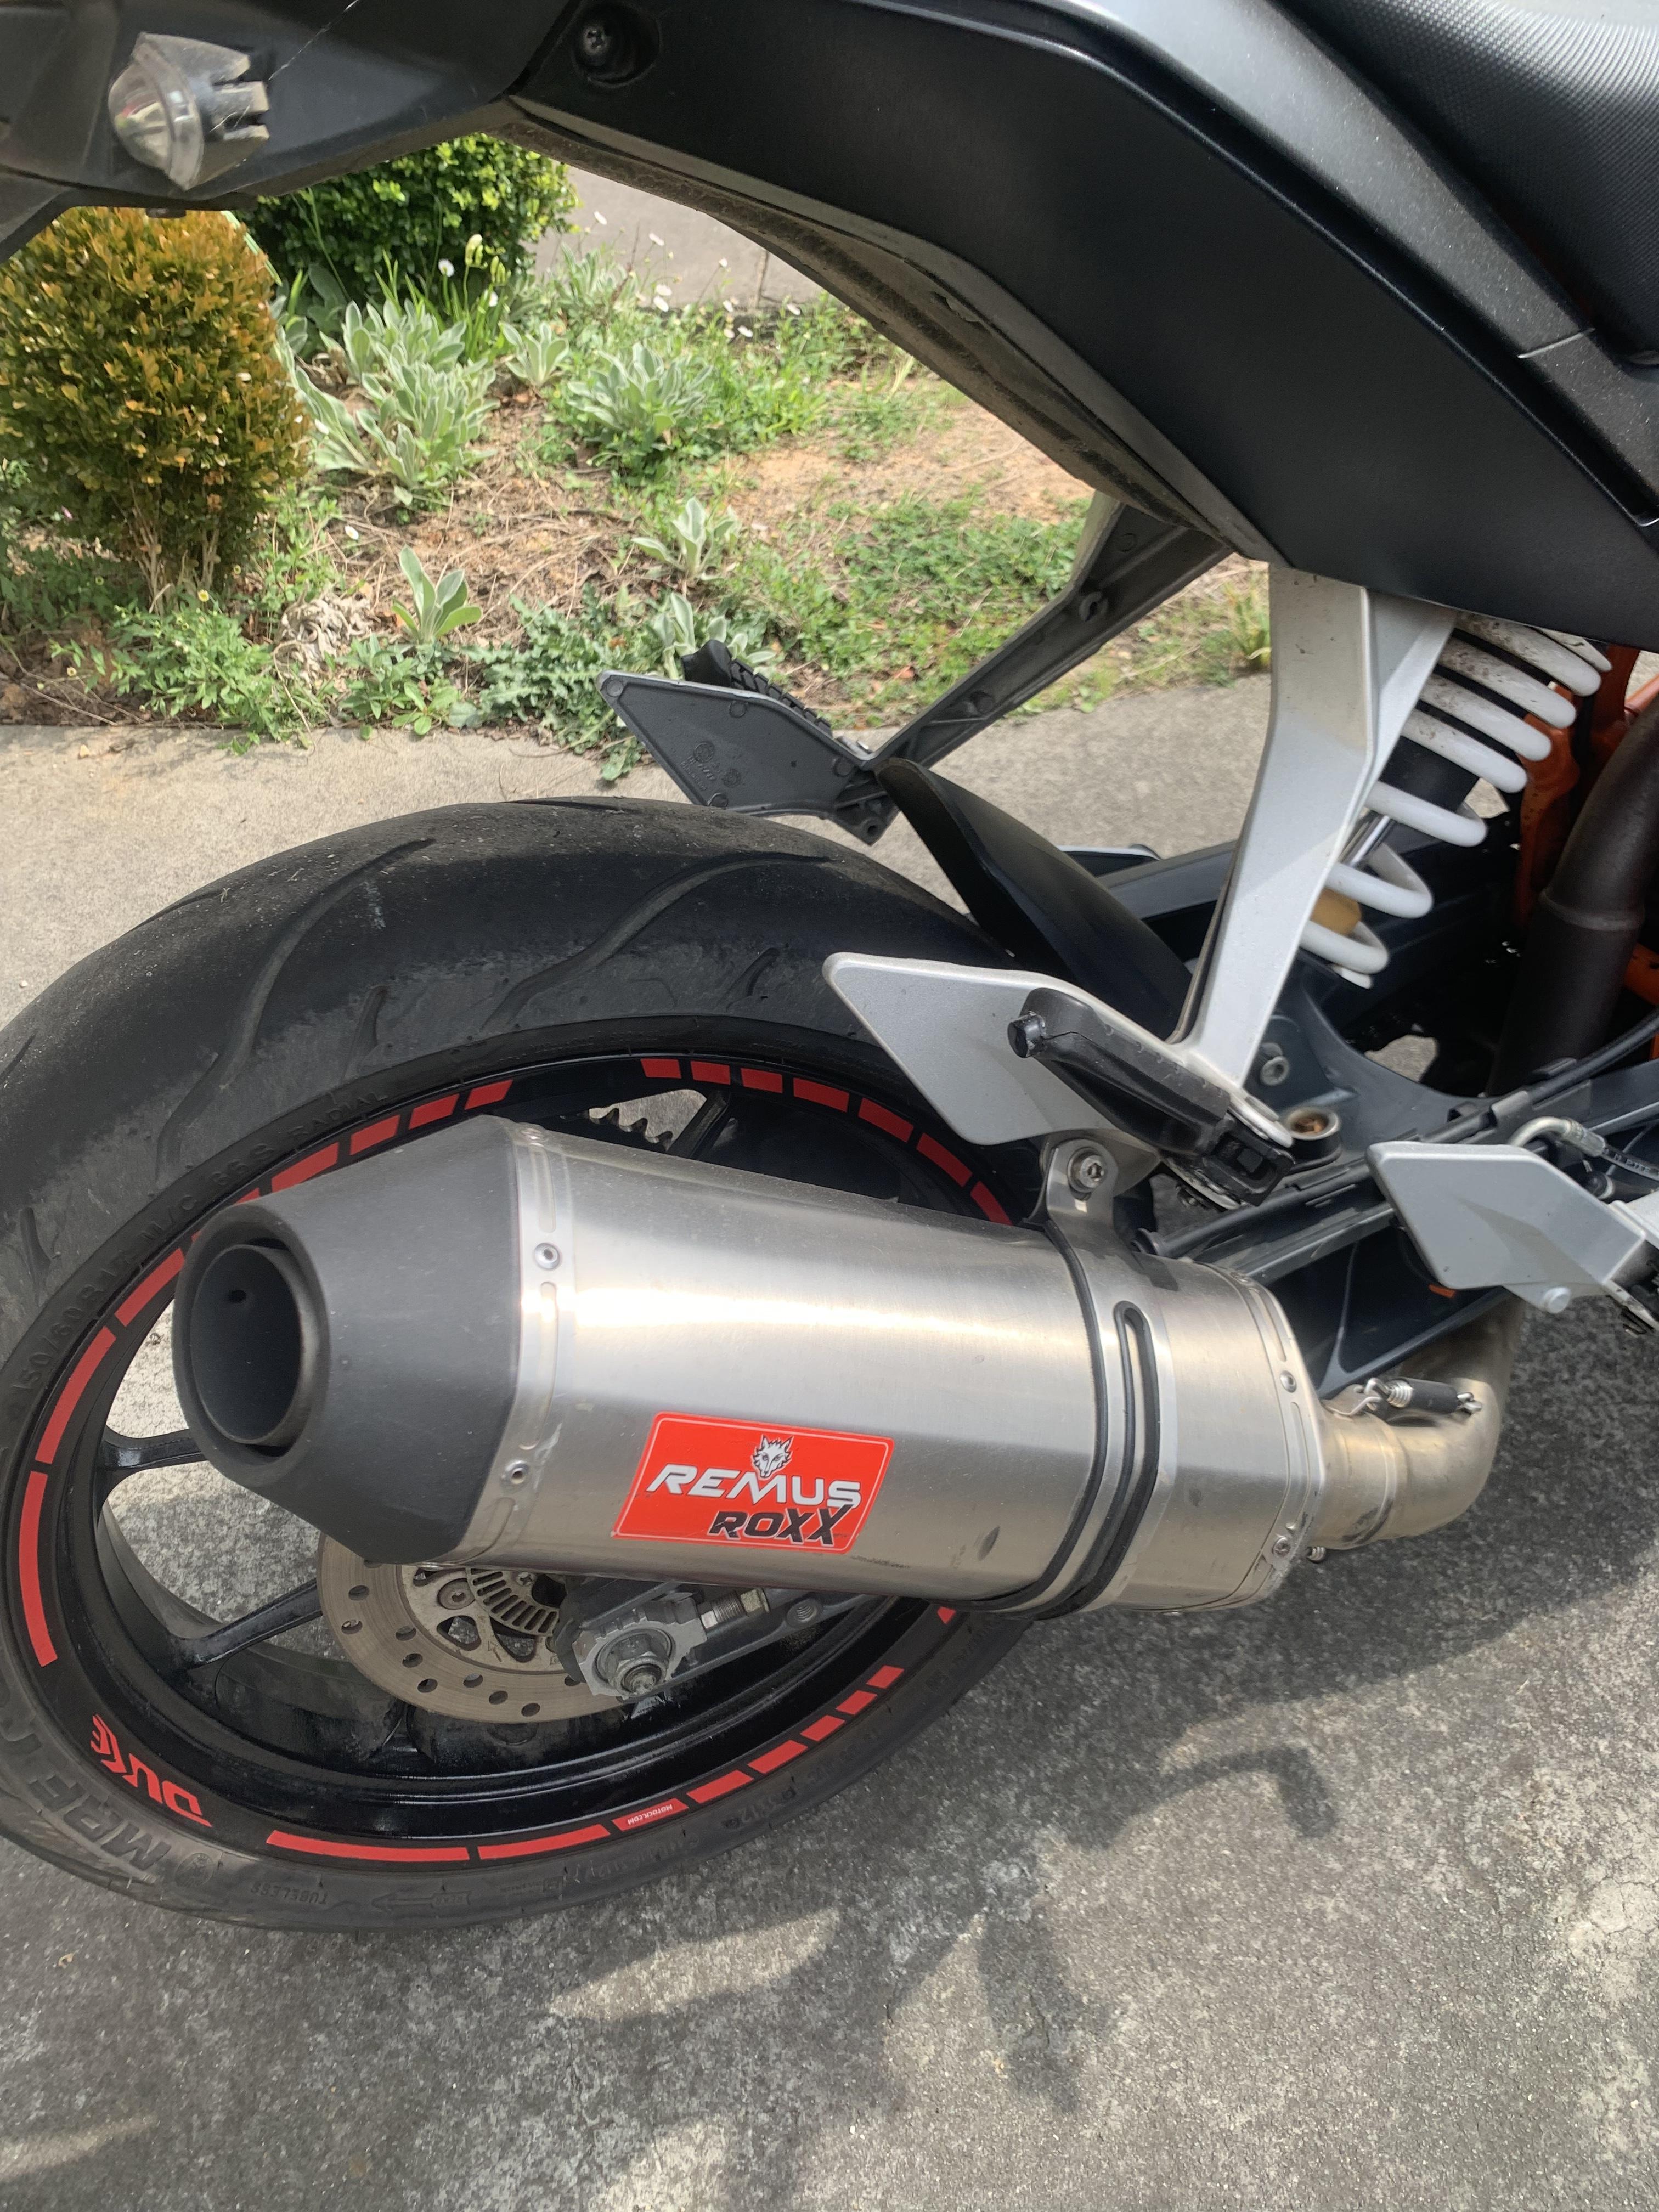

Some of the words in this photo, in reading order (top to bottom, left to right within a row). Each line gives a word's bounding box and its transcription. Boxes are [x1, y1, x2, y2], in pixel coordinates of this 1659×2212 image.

[646, 1464, 861, 1509] REMUS
[708, 1504, 854, 1545] ROXX
[91, 1714, 212, 1827] DUKE
[28, 1775, 171, 1871] MRF
[250, 1881, 328, 1905] TUBELESS
[435, 1895, 463, 1906] REAR
